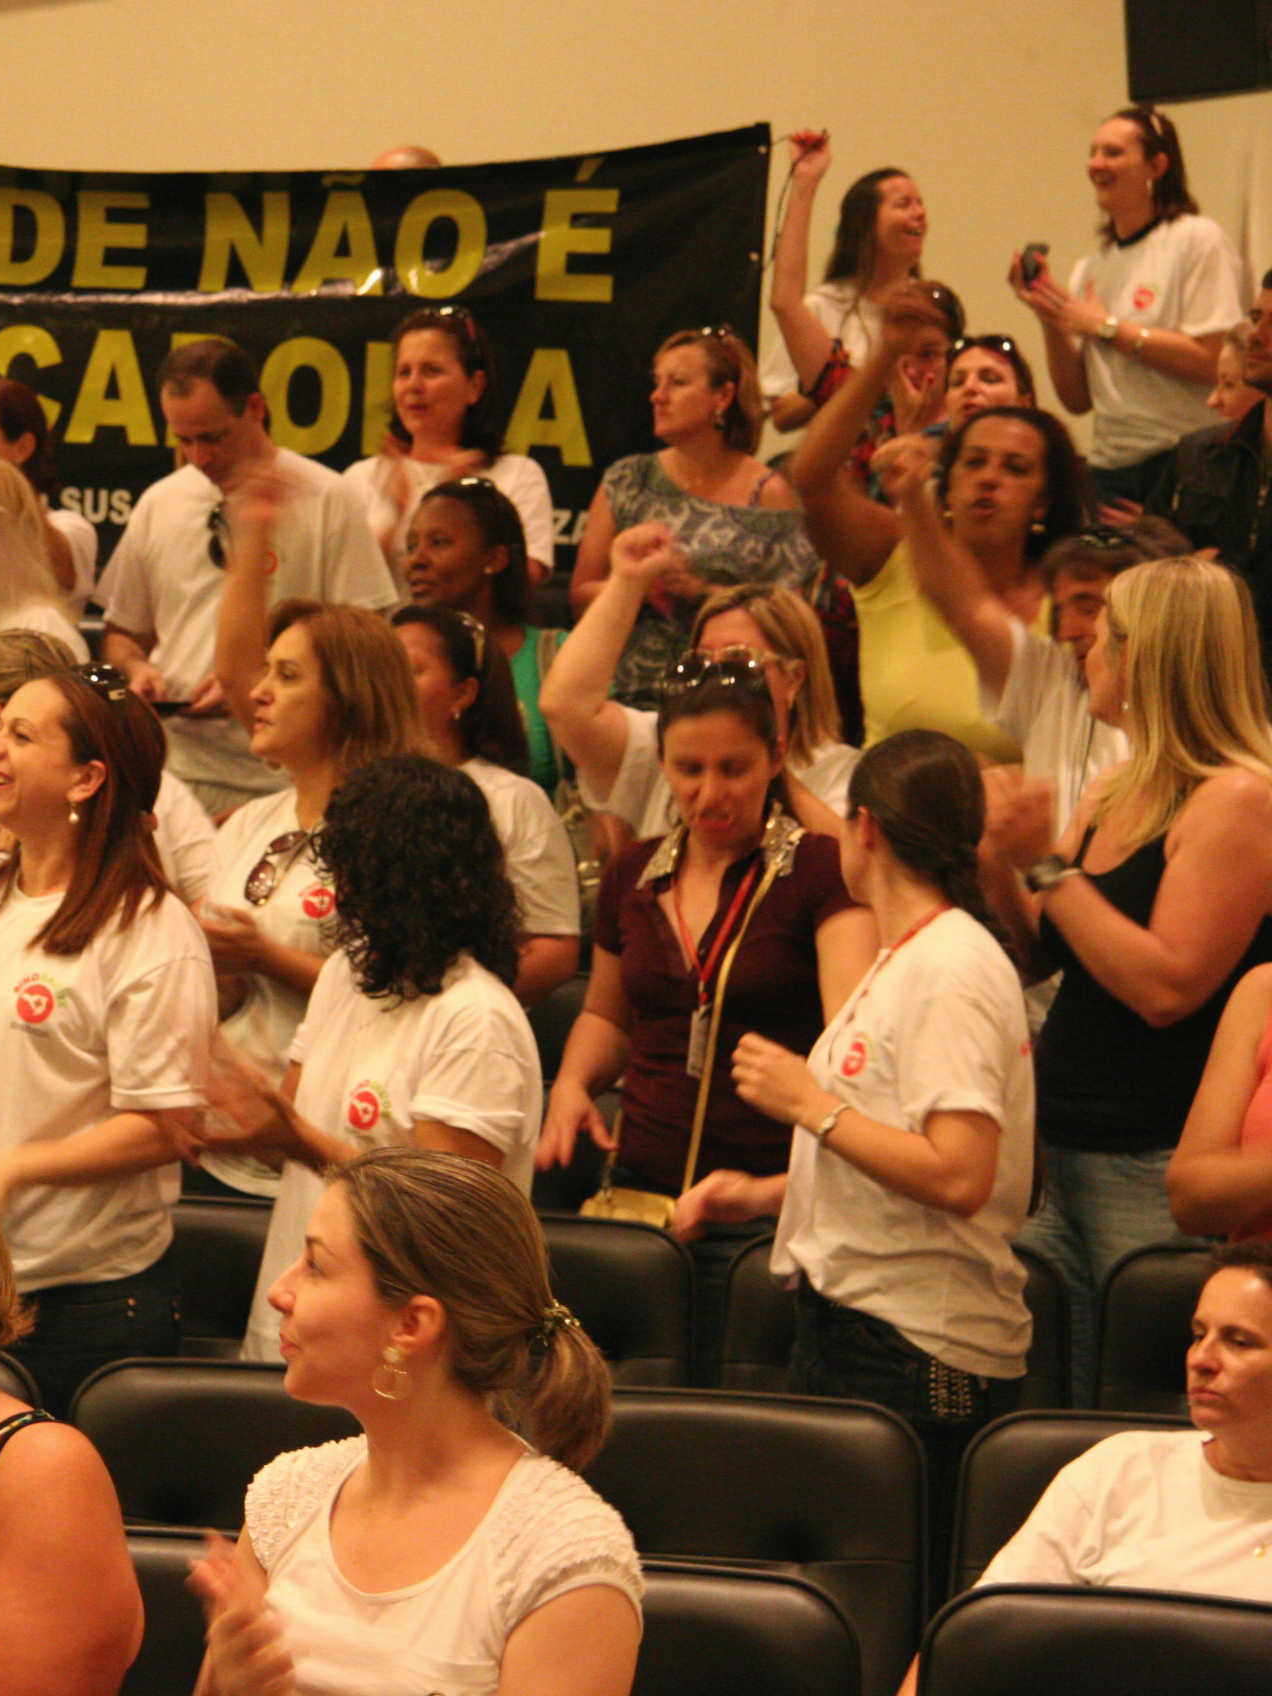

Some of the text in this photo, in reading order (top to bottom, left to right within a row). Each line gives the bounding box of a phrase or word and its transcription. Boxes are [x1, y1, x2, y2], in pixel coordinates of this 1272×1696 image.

[197, 172, 488, 299] NÃO
[535, 158, 621, 303] É
[59, 486, 133, 526] SUS
